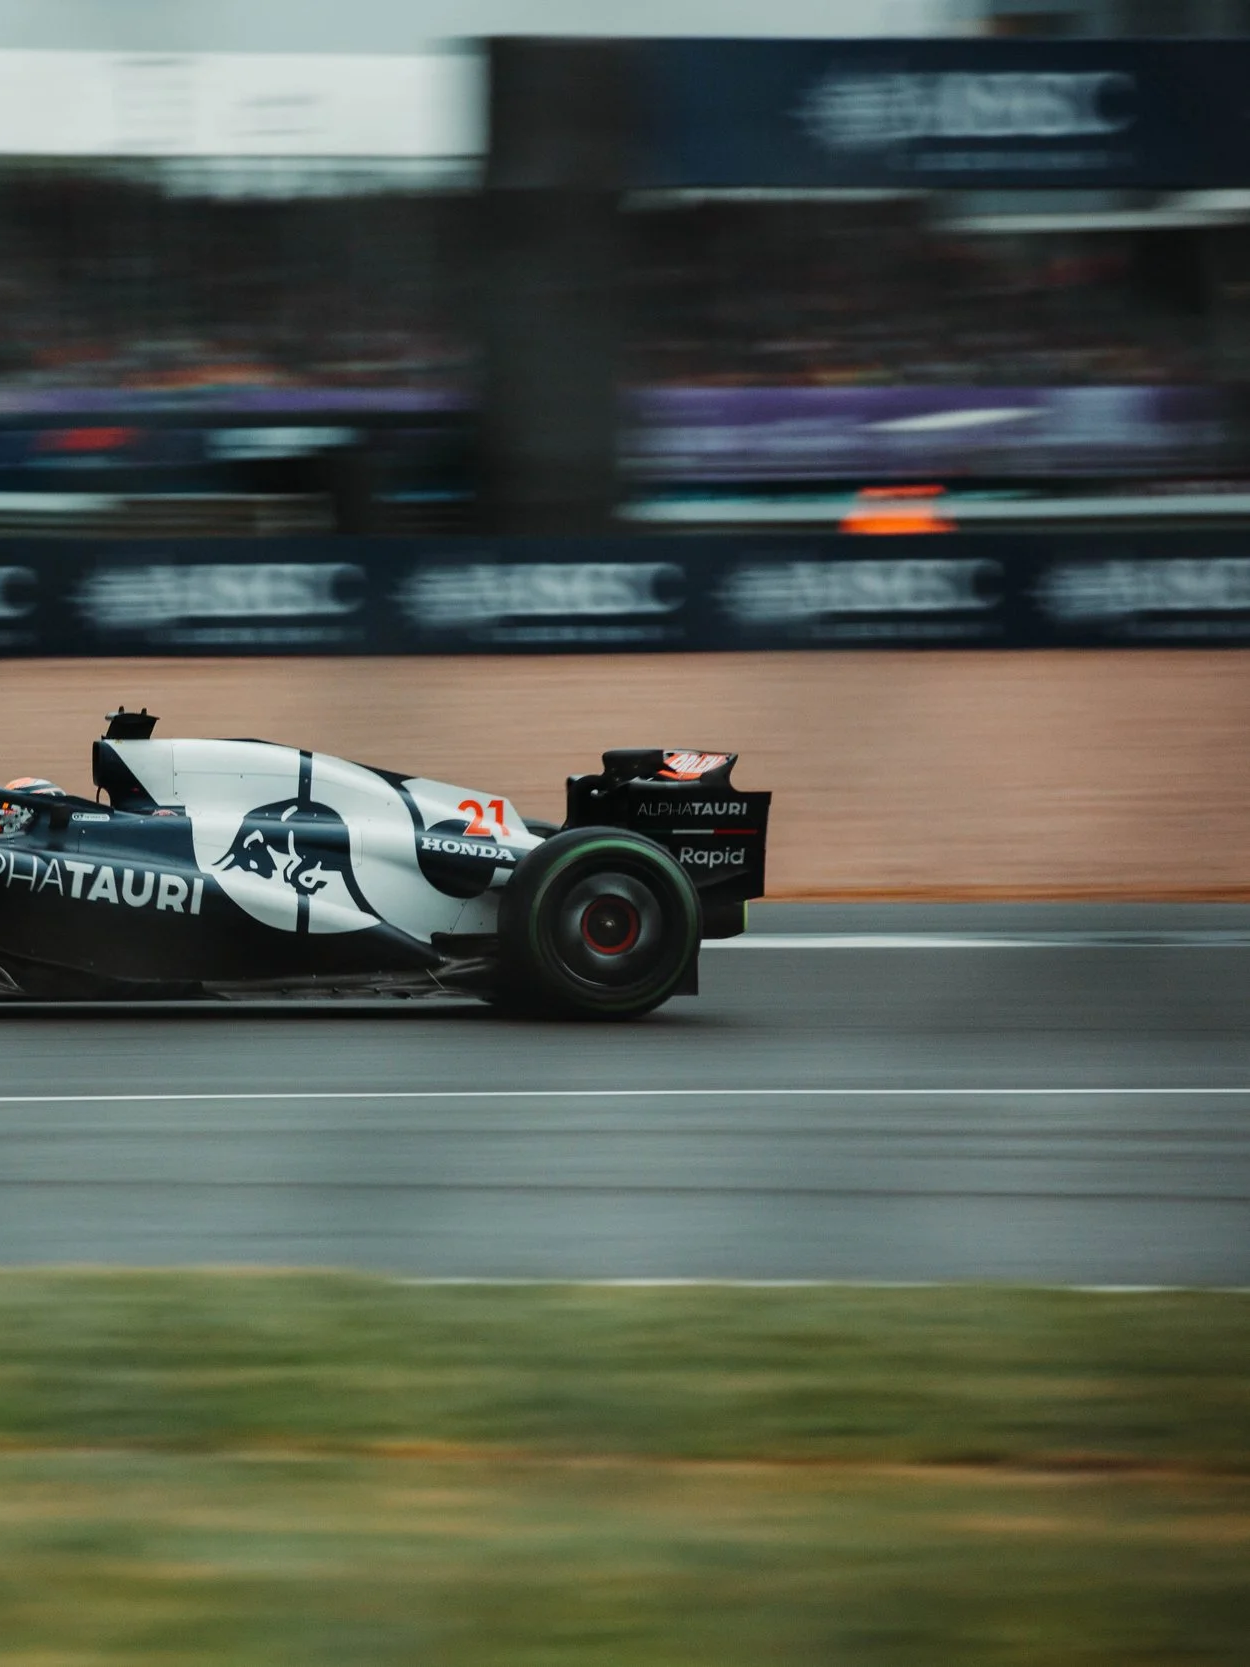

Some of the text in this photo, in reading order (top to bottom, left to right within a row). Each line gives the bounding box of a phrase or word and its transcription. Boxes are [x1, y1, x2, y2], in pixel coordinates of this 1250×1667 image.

[457, 799, 510, 836] 21
[637, 802, 748, 816] ALPHATAURI
[421, 837, 516, 861] HONDA
[680, 846, 746, 868] Rapid
